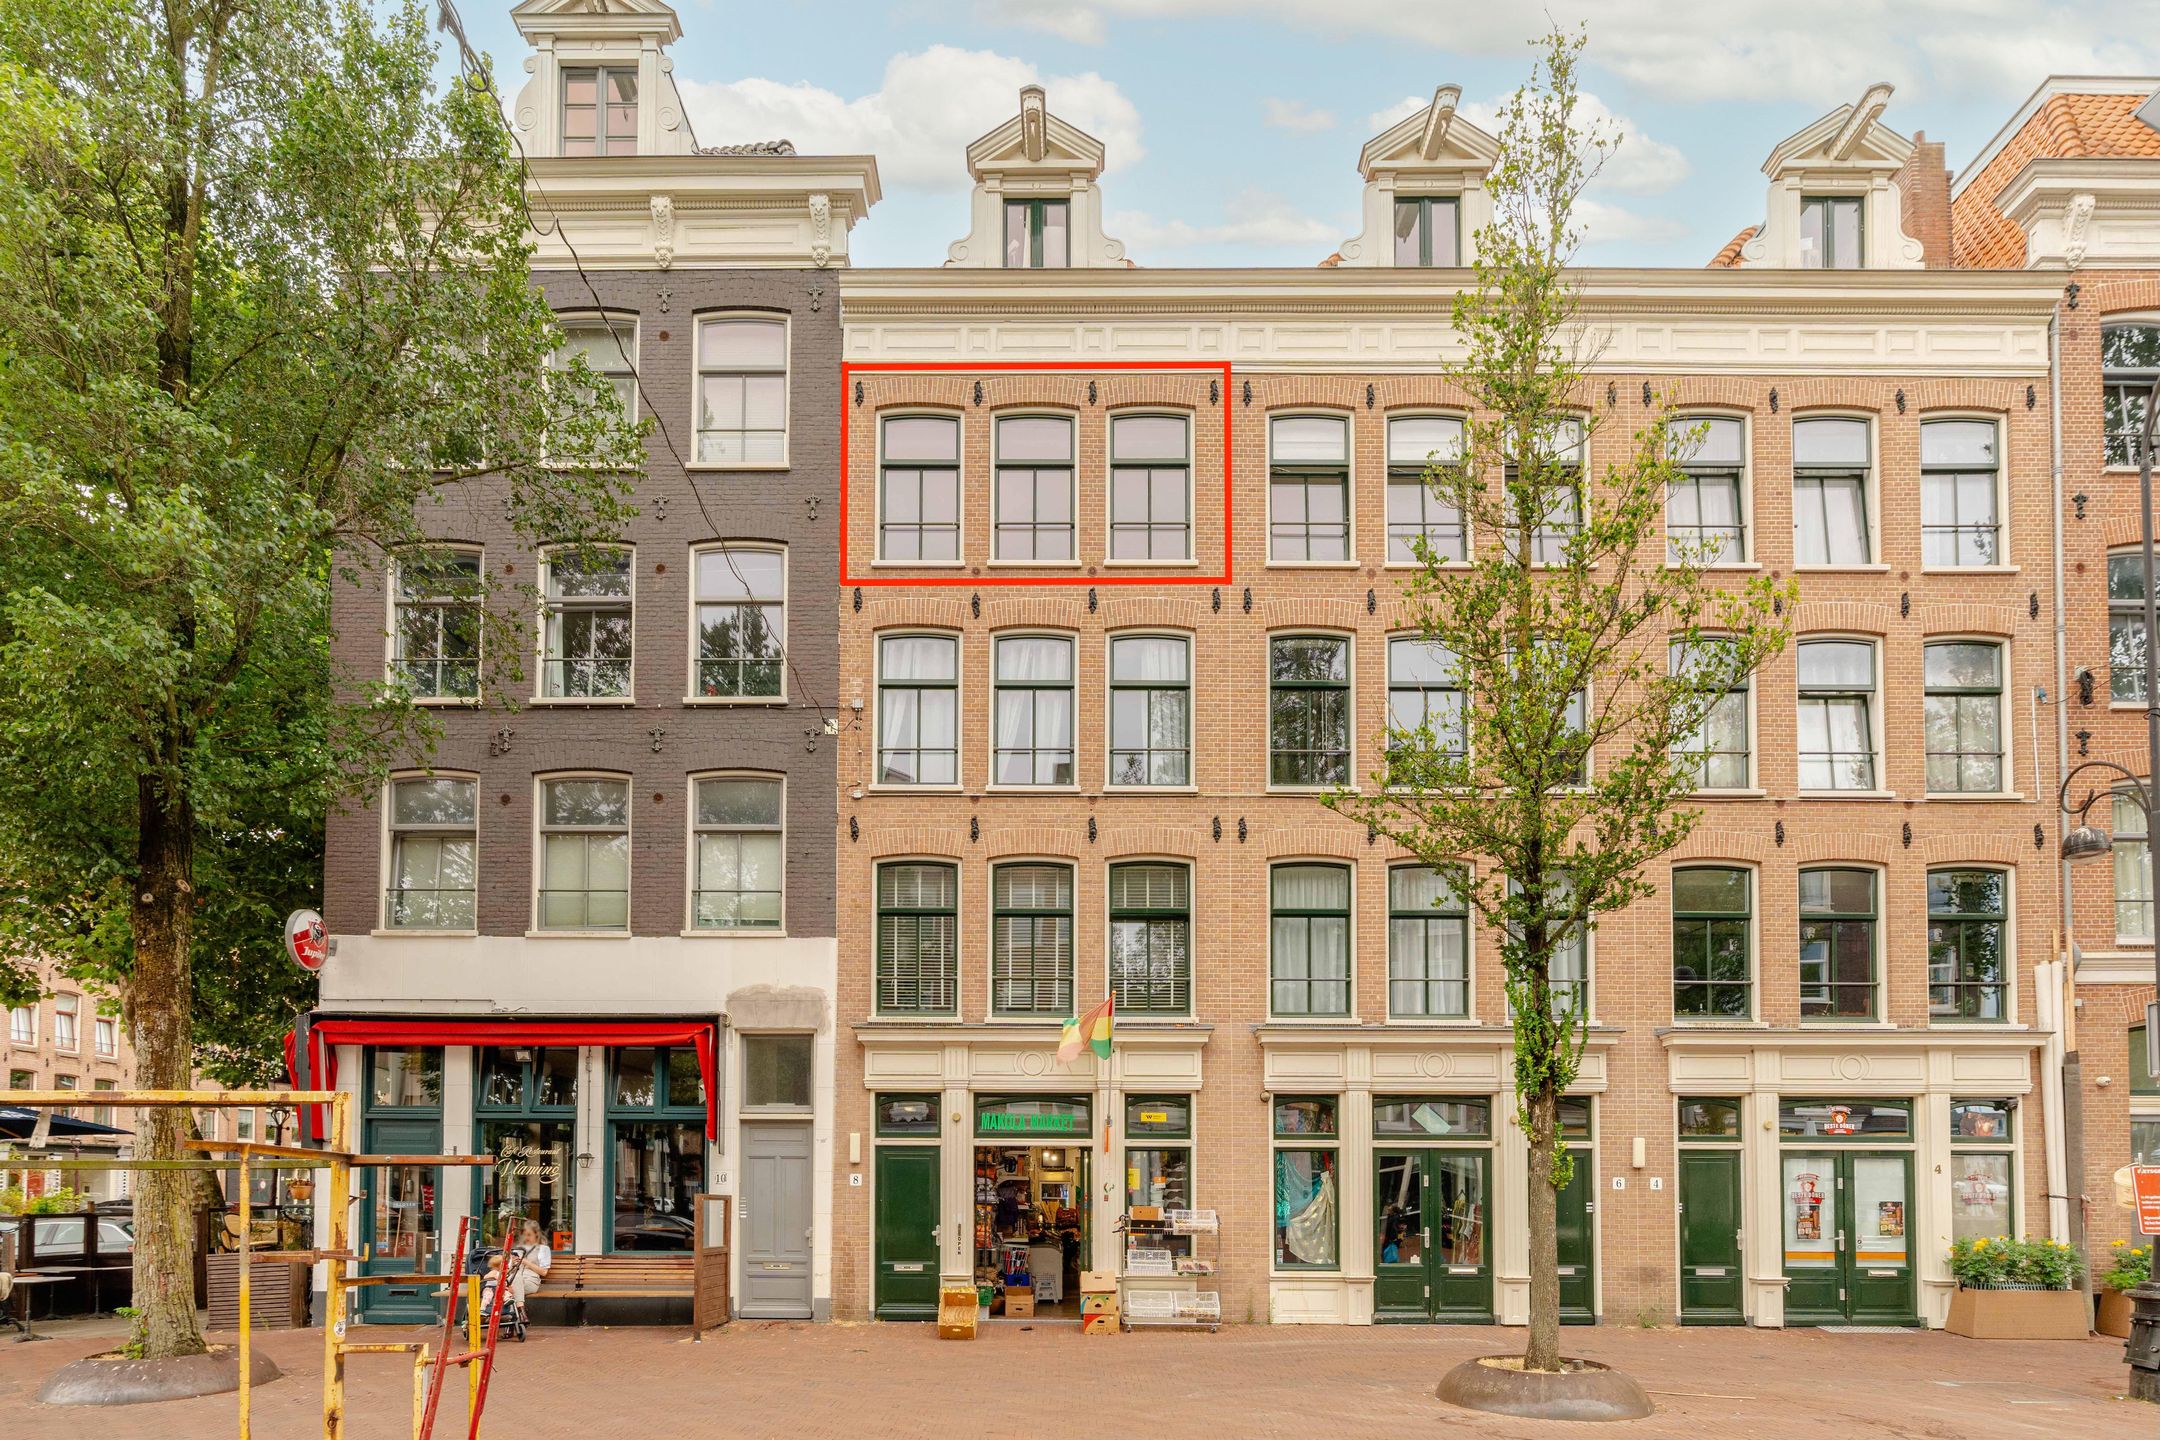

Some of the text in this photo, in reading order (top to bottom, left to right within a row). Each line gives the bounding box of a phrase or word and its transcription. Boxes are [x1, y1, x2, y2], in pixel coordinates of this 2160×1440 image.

[981, 1113, 1073, 1131] MAKOLA MARKET
[1934, 1165, 1942, 1174] 4
[716, 1174, 727, 1183] 10
[853, 1175, 859, 1184] 8
[1615, 1179, 1622, 1188] 6
[1653, 1179, 1659, 1188] 4
